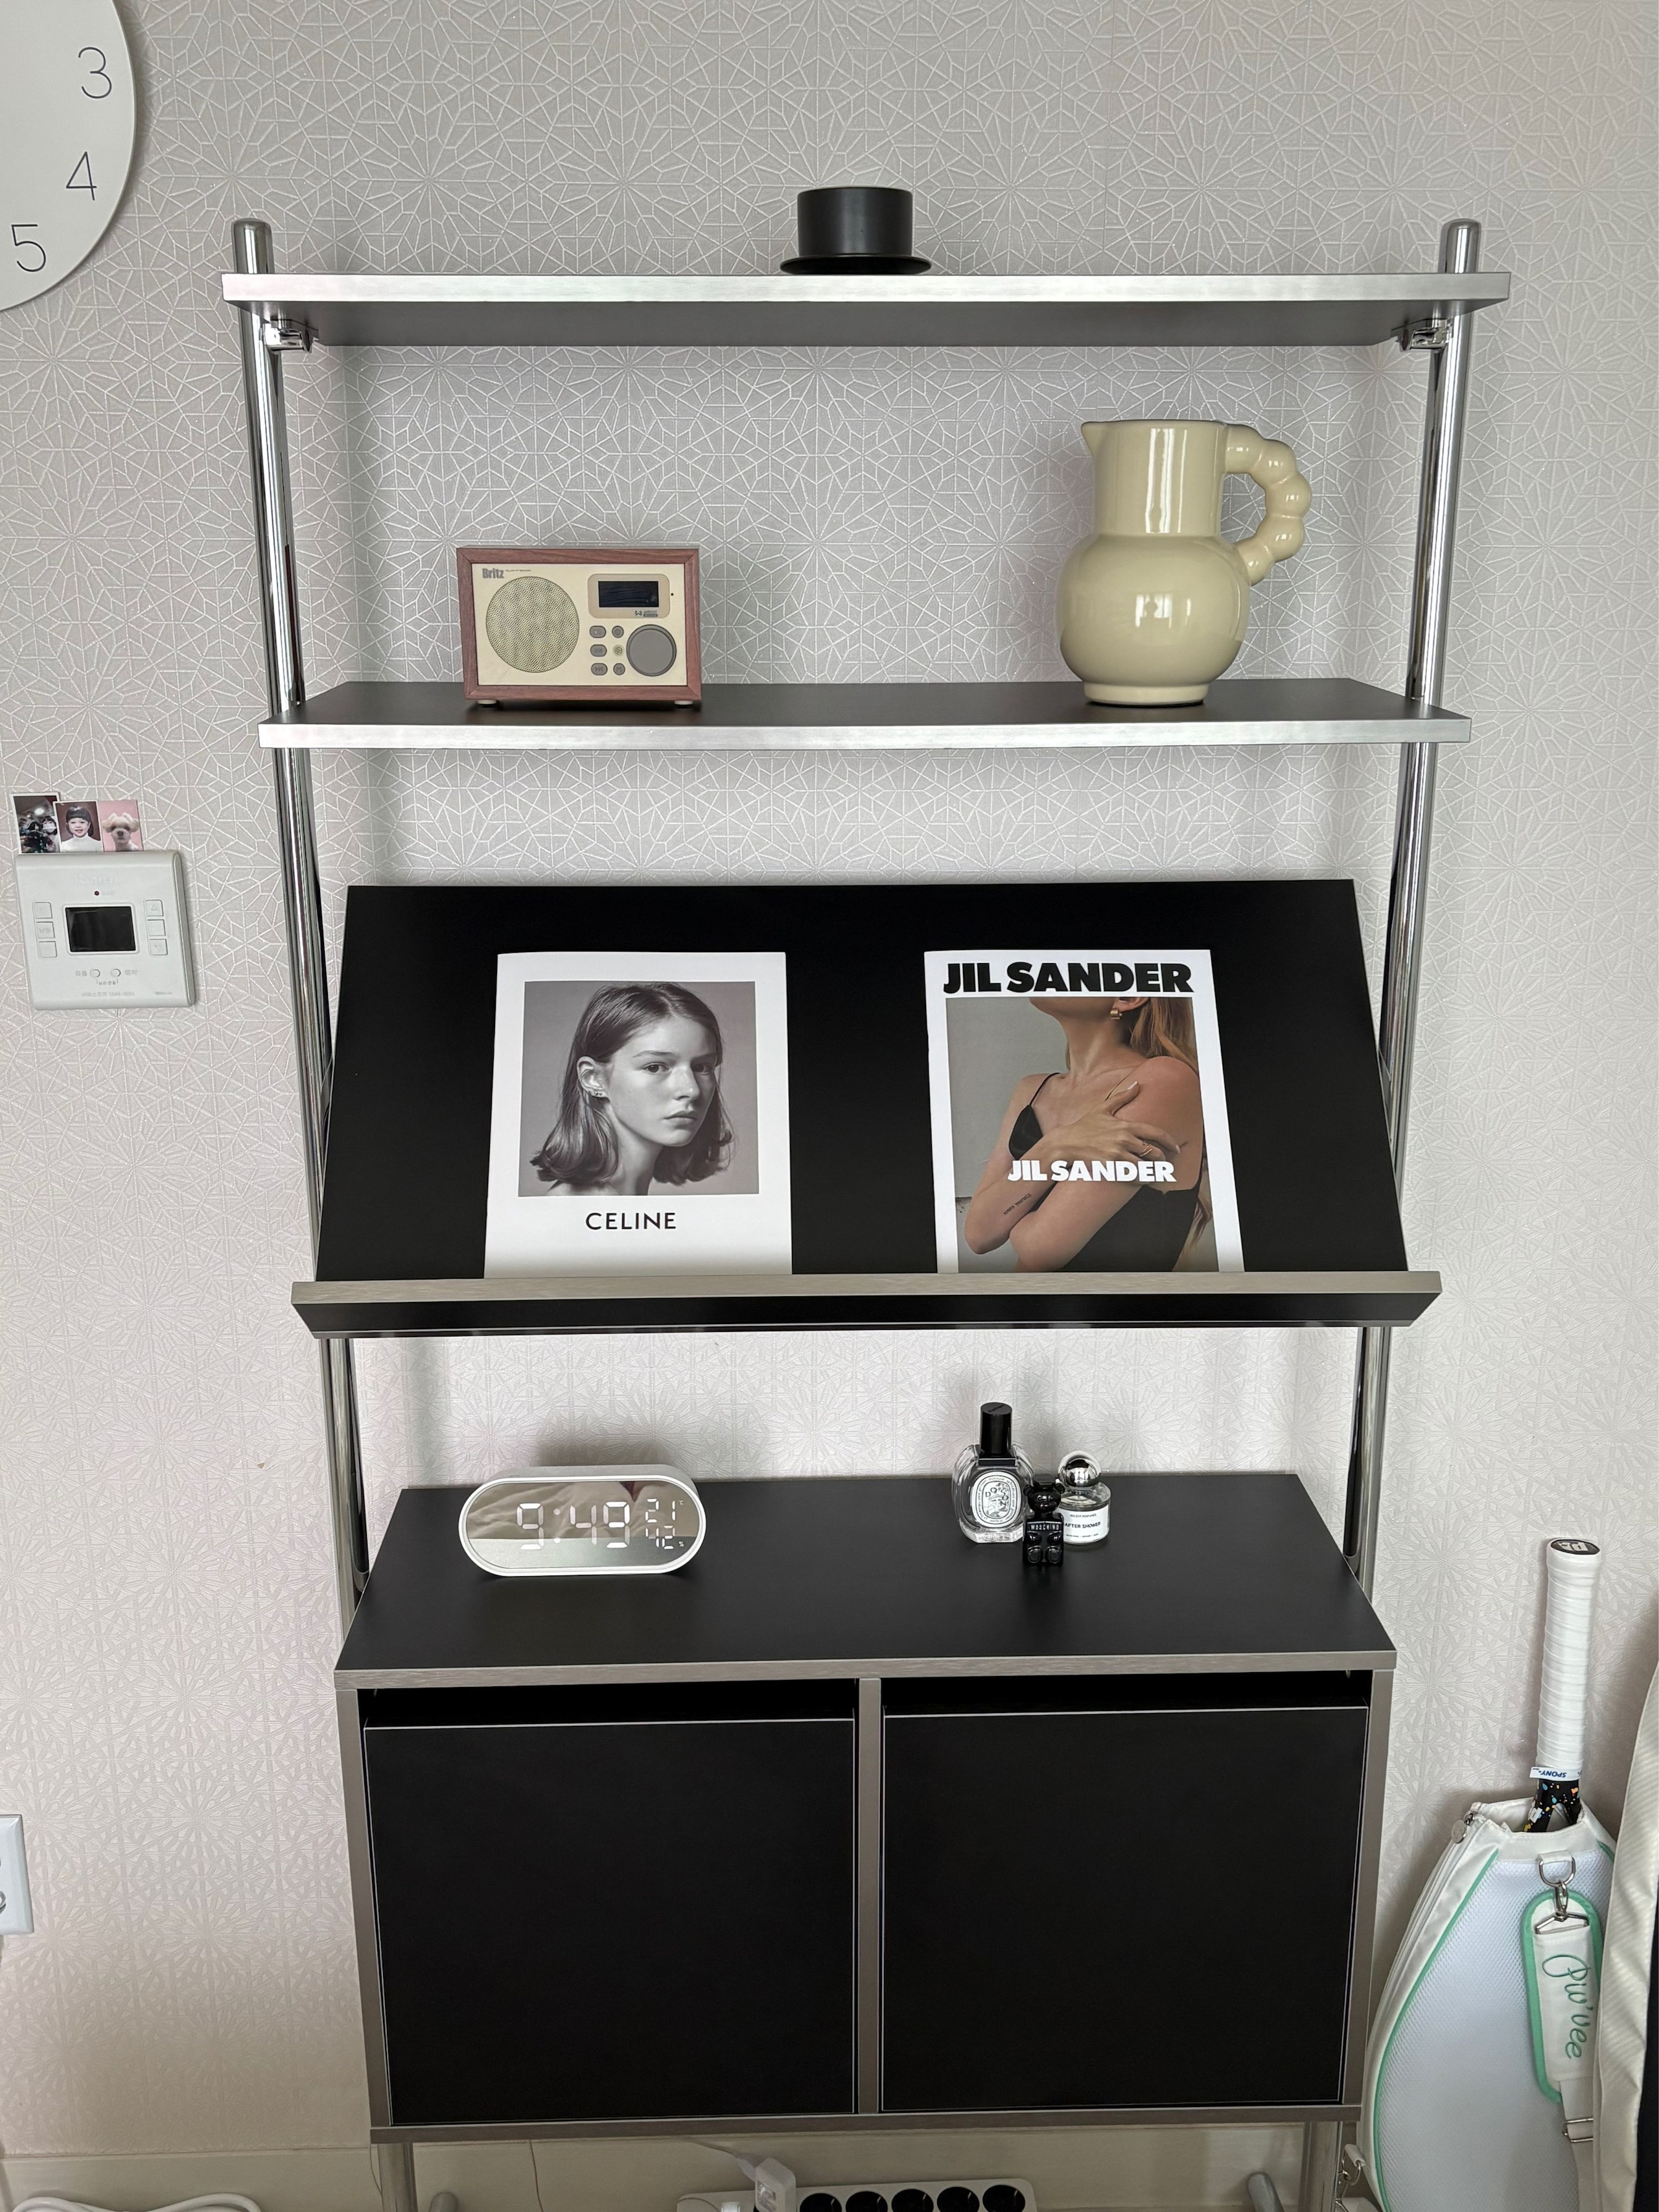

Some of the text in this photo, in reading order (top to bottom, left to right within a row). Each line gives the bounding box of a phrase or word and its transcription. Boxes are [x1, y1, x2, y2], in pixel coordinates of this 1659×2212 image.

[78, 47, 111, 99] 3
[66, 152, 97, 200] 4
[12, 224, 46, 272] 5
[481, 568, 504, 579] Britz
[944, 962, 1194, 994] JIL SANDER
[1008, 1160, 1176, 1182] JIL SANDER
[585, 1212, 677, 1230] CELINE
[517, 1501, 630, 1550] 9:49
[1540, 1770, 1567, 1778] SPONY
